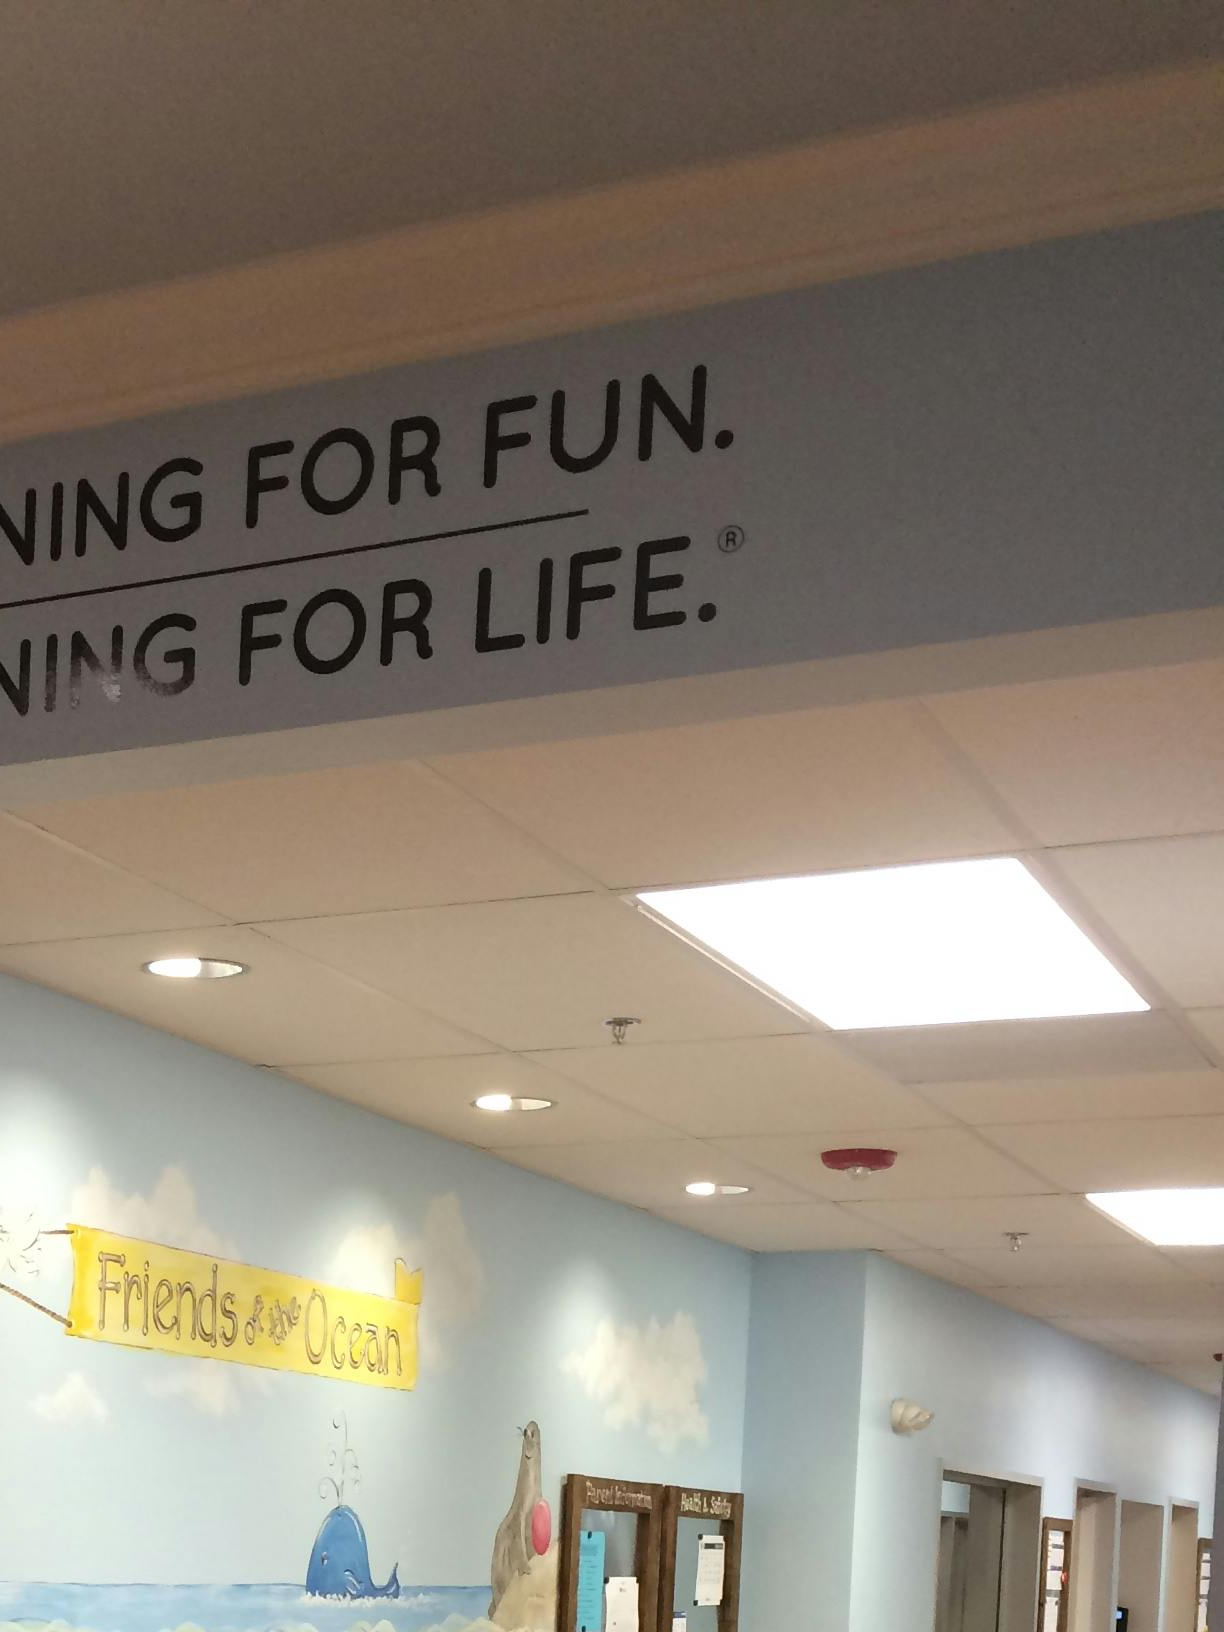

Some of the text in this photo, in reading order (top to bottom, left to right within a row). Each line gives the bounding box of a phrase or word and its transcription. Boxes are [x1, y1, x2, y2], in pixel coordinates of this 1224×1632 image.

[243, 414, 443, 529] FOR
[482, 364, 736, 489] FUN.
[238, 576, 433, 686] FOR
[473, 534, 718, 655] LIFE.
[97, 1251, 403, 1377] Friends of the Ocean
[680, 1492, 702, 1513] Health
[709, 1495, 732, 1520] Safety
